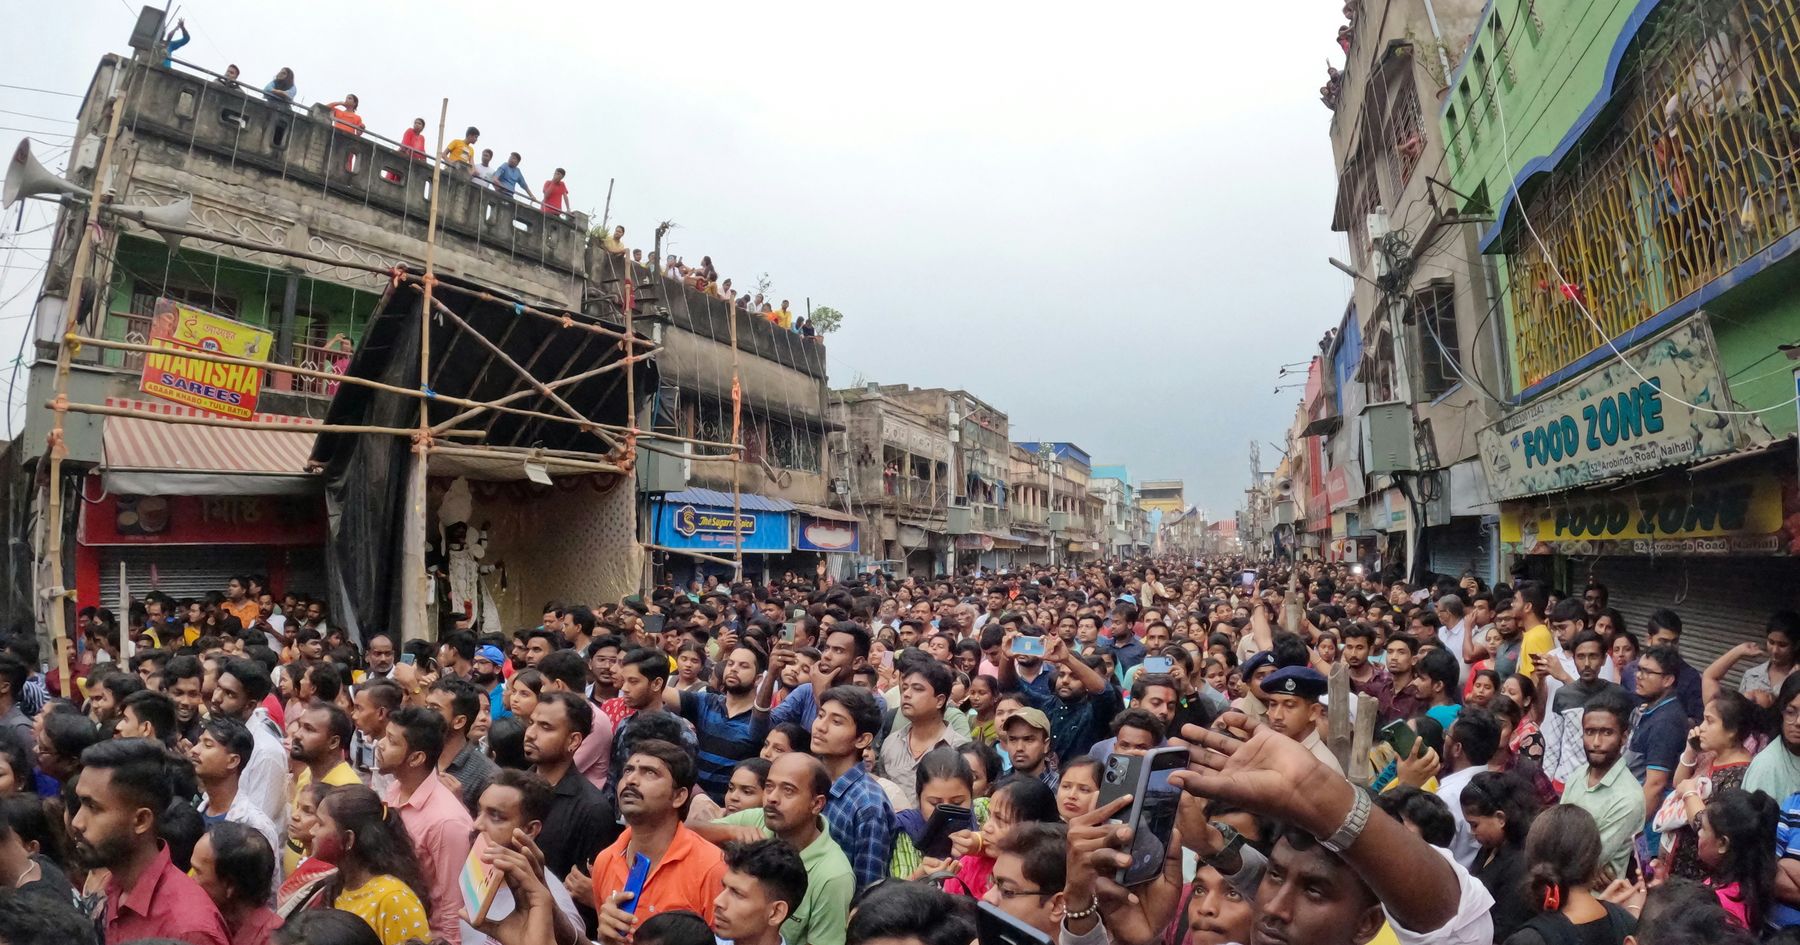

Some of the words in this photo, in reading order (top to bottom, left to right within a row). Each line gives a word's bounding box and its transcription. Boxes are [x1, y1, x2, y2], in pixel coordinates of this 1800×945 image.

[148, 337, 258, 397] MANISHA
[161, 373, 241, 405] SAREES
[1522, 414, 1579, 469] FOOD
[1582, 375, 1664, 452] ZONE
[1601, 456, 1633, 471] Arobinda
[1660, 439, 1692, 458] Naihati
[699, 516, 711, 526] The
[1555, 502, 1629, 536] FOOD
[1636, 486, 1753, 534] ZONE
